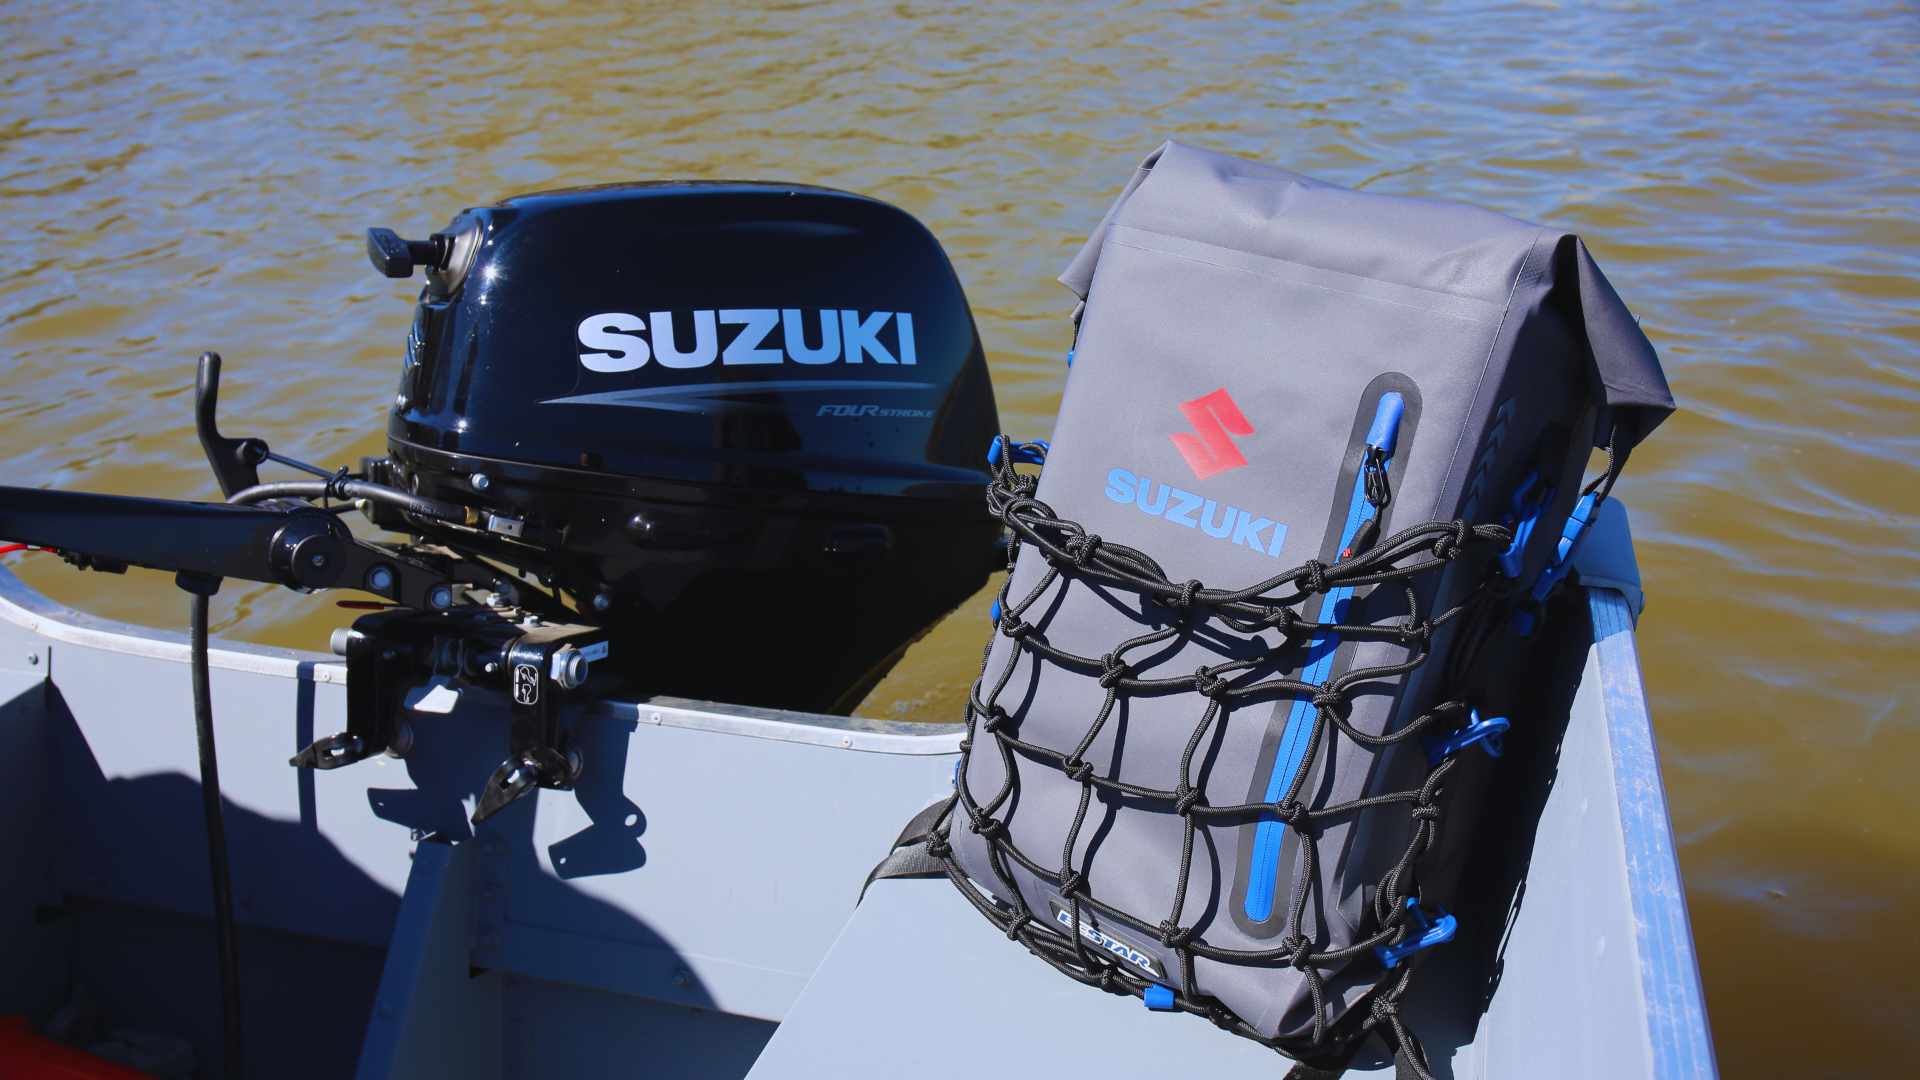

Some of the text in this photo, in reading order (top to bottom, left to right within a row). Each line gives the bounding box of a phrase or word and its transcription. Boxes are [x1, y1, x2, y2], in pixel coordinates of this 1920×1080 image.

[577, 308, 917, 373] SUZUKI
[816, 403, 936, 418] FOUR STROKE
[1104, 467, 1288, 558] SUZUKI
